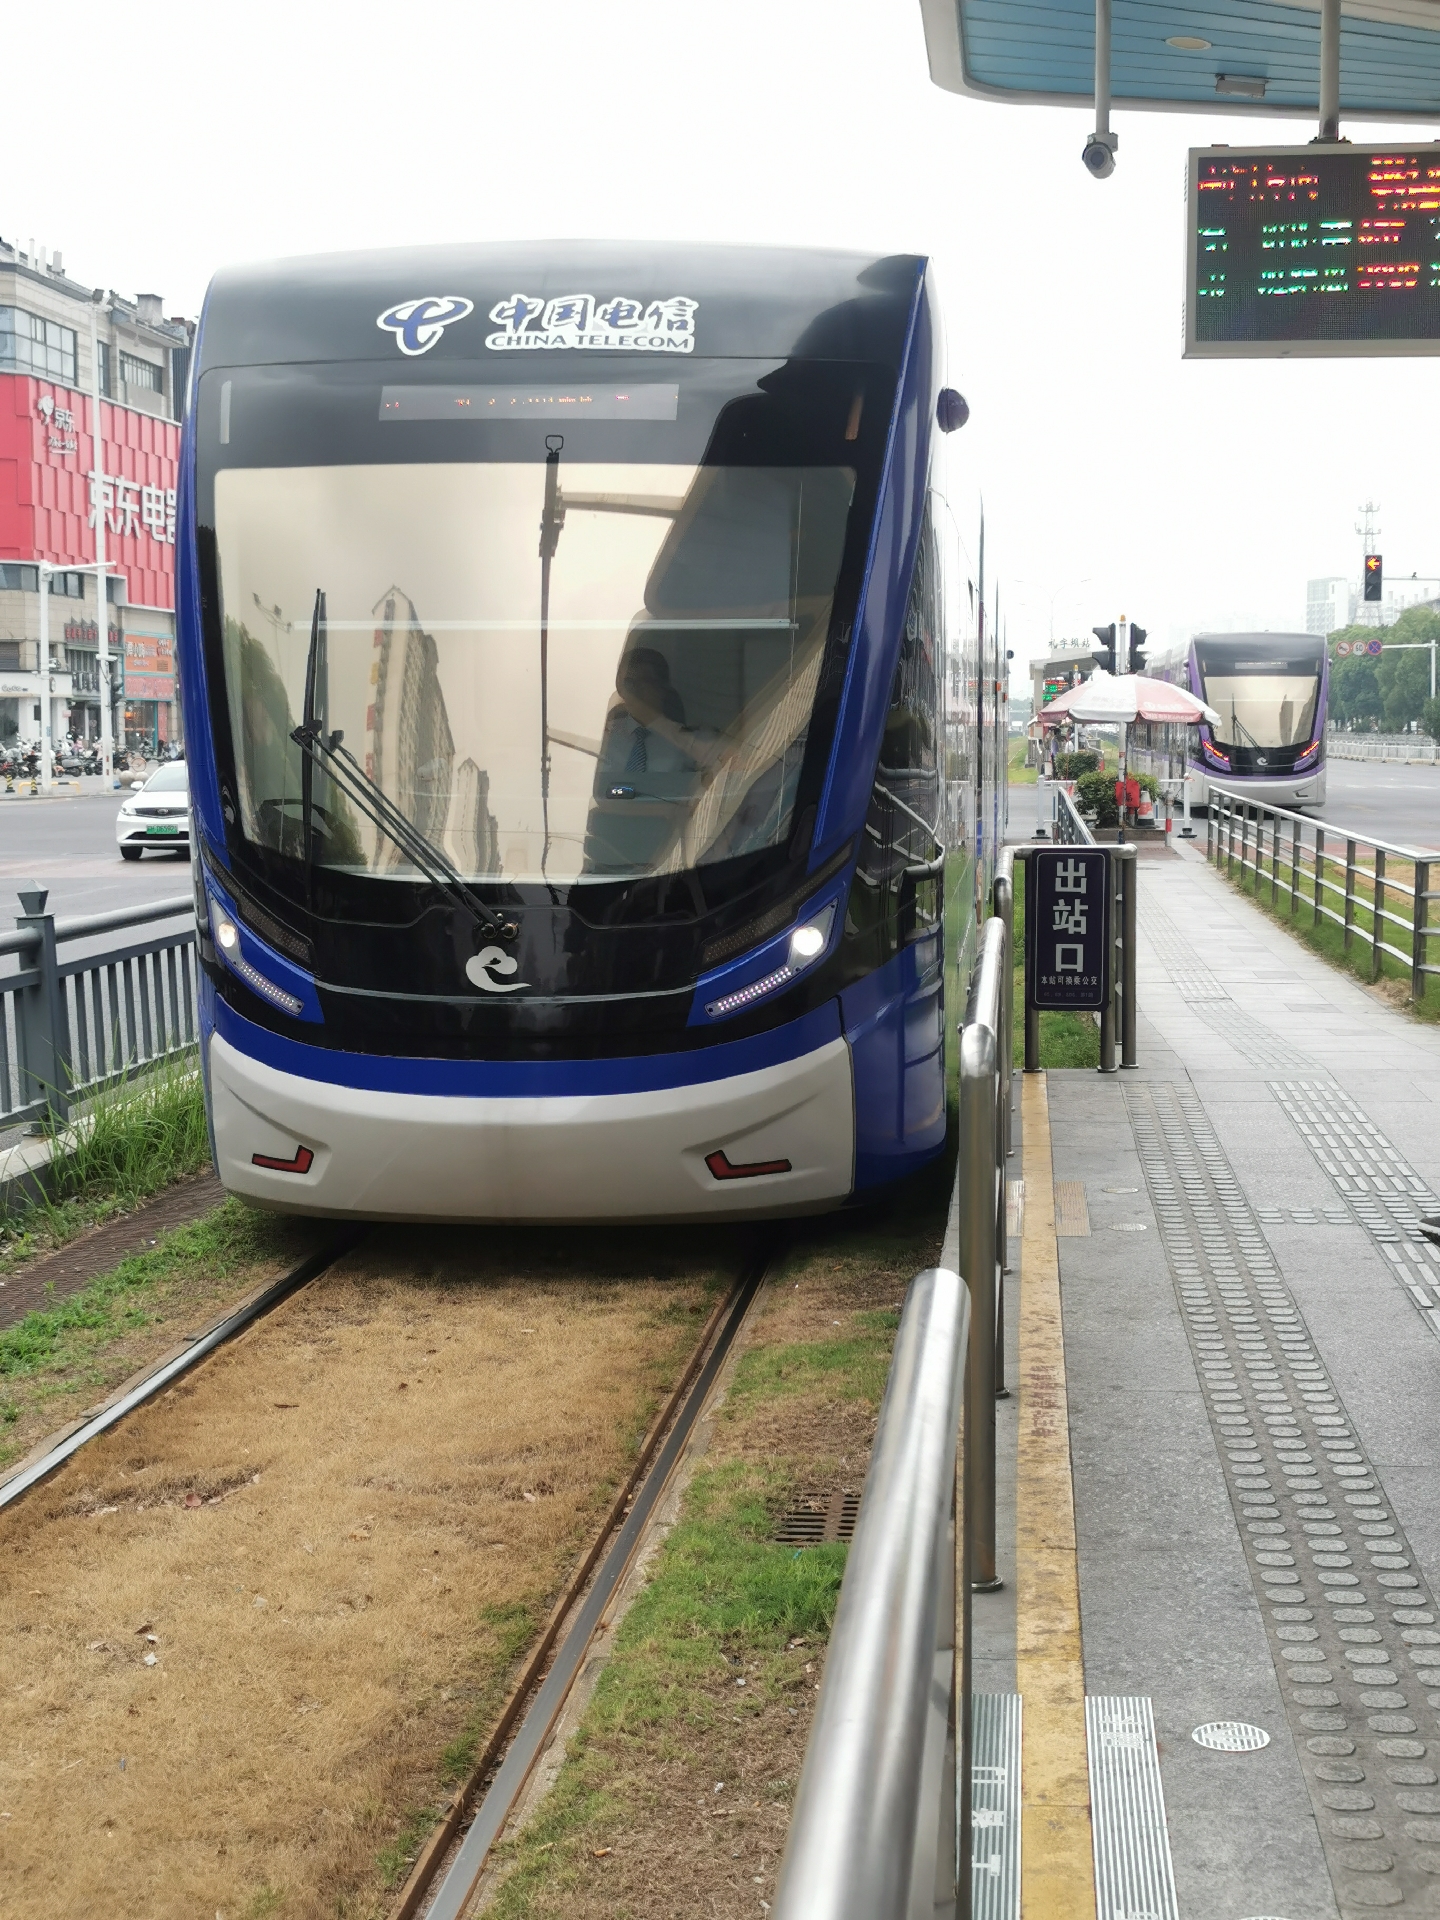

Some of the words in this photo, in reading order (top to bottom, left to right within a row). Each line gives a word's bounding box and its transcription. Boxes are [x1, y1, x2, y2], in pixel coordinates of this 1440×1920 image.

[491, 295, 698, 333] 中国电信
[491, 334, 567, 347] CHINA
[575, 334, 689, 349] TELECOM
[1052, 858, 1089, 973] 出站口
[1041, 975, 1098, 986] 本站可换乘公交
